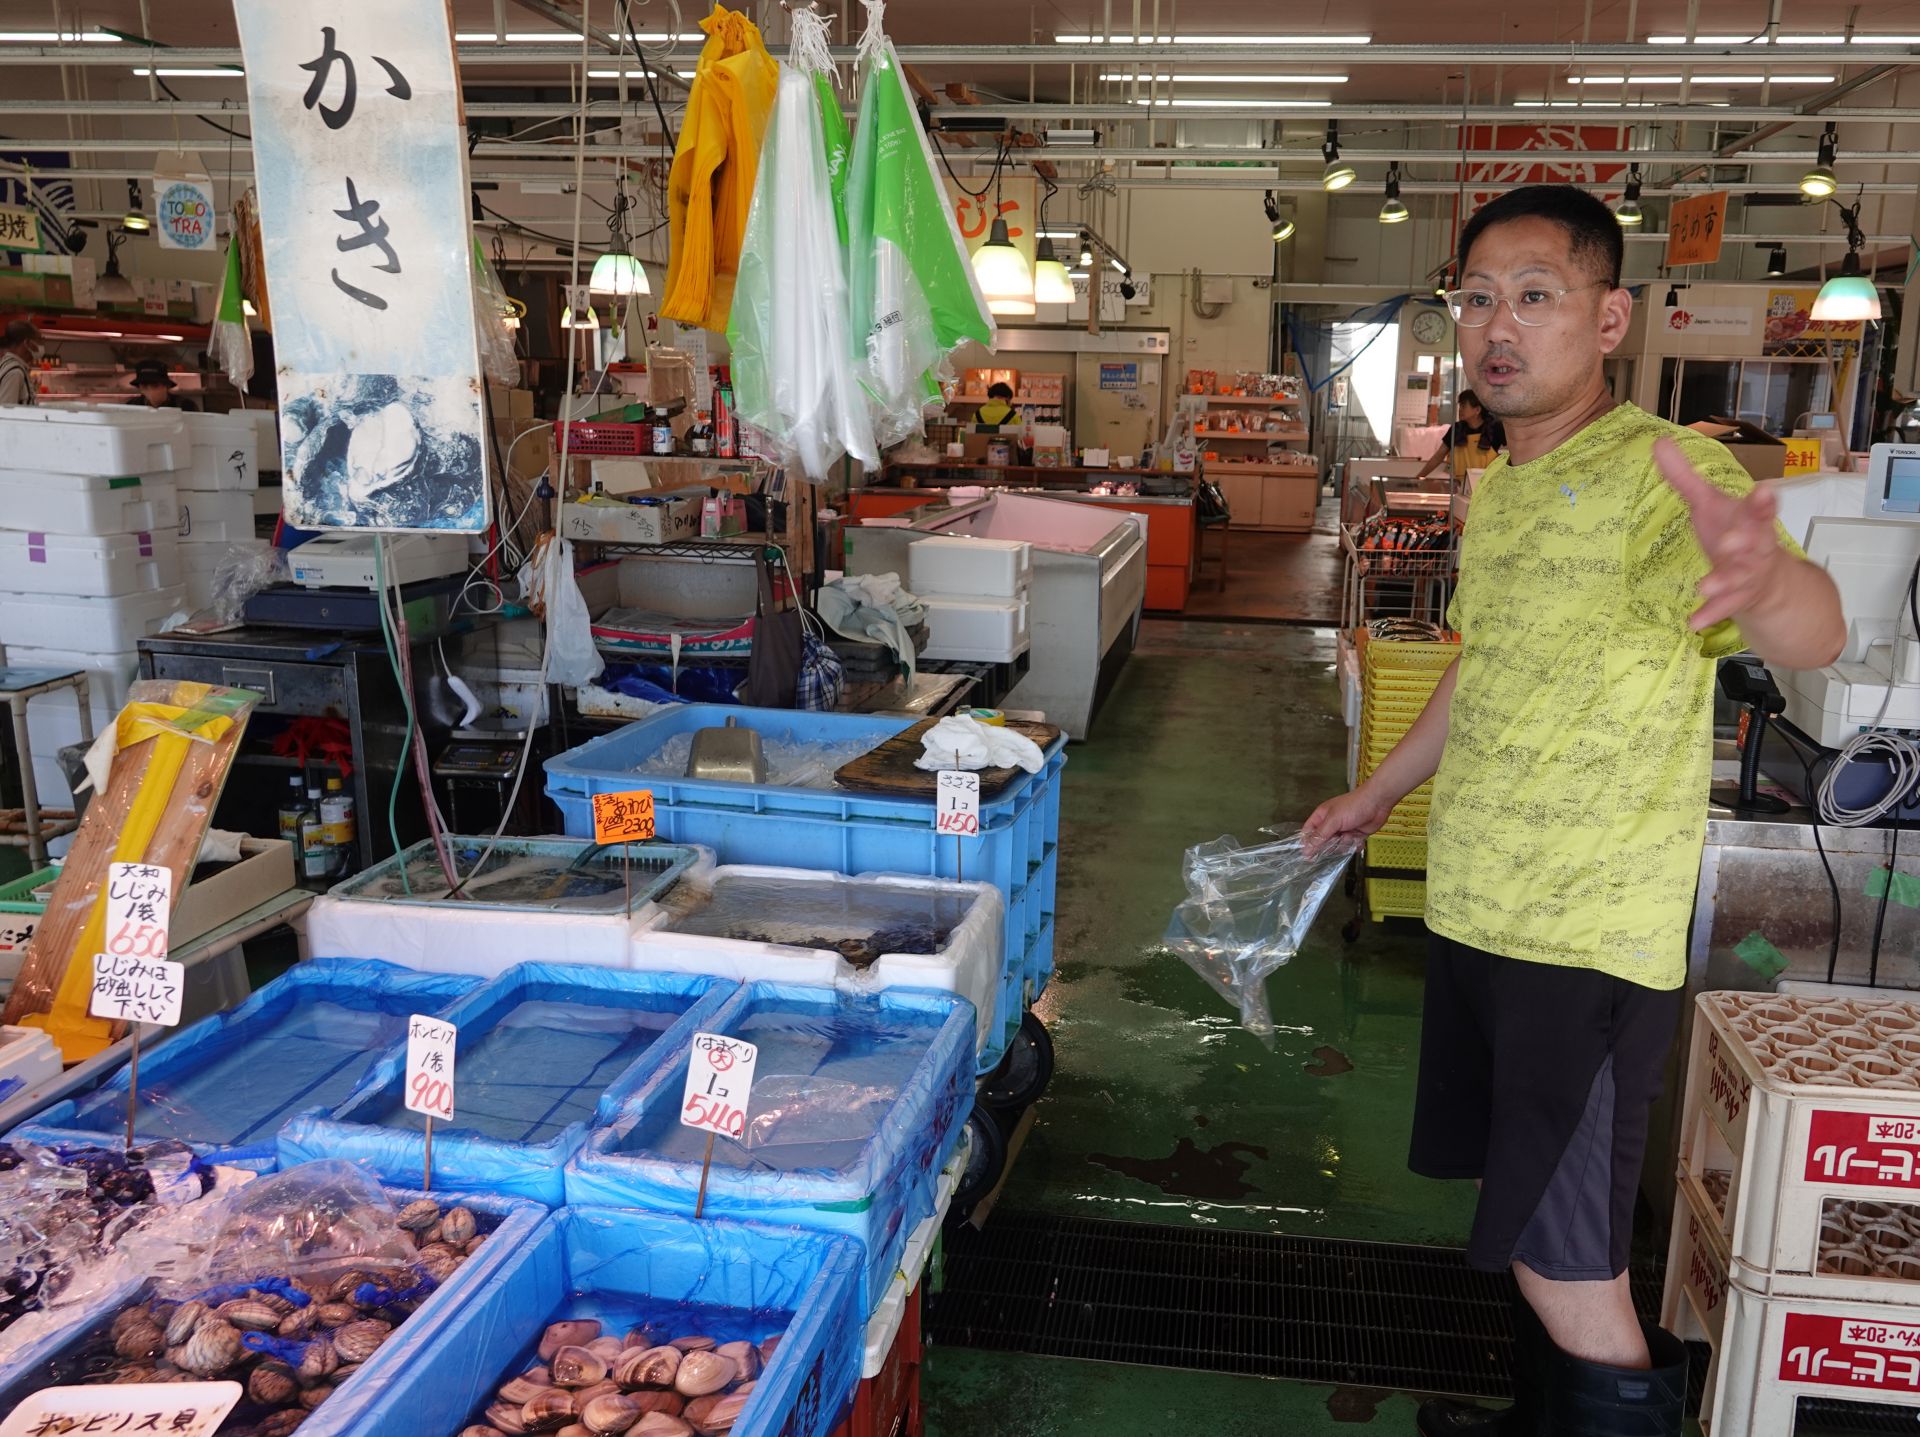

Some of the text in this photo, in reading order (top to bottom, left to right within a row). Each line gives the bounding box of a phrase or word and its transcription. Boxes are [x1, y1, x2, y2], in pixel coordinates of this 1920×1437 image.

[298, 26, 412, 311] かき
[169, 217, 202, 235] TRA
[1784, 450, 1817, 468] 会計
[120, 864, 160, 879] 大和
[109, 880, 168, 903] しじみ
[96, 955, 168, 982] しじみは
[95, 976, 176, 1004] 砂出しして
[113, 999, 166, 1021] 下さい
[1813, 1144, 1920, 1182] ビール
